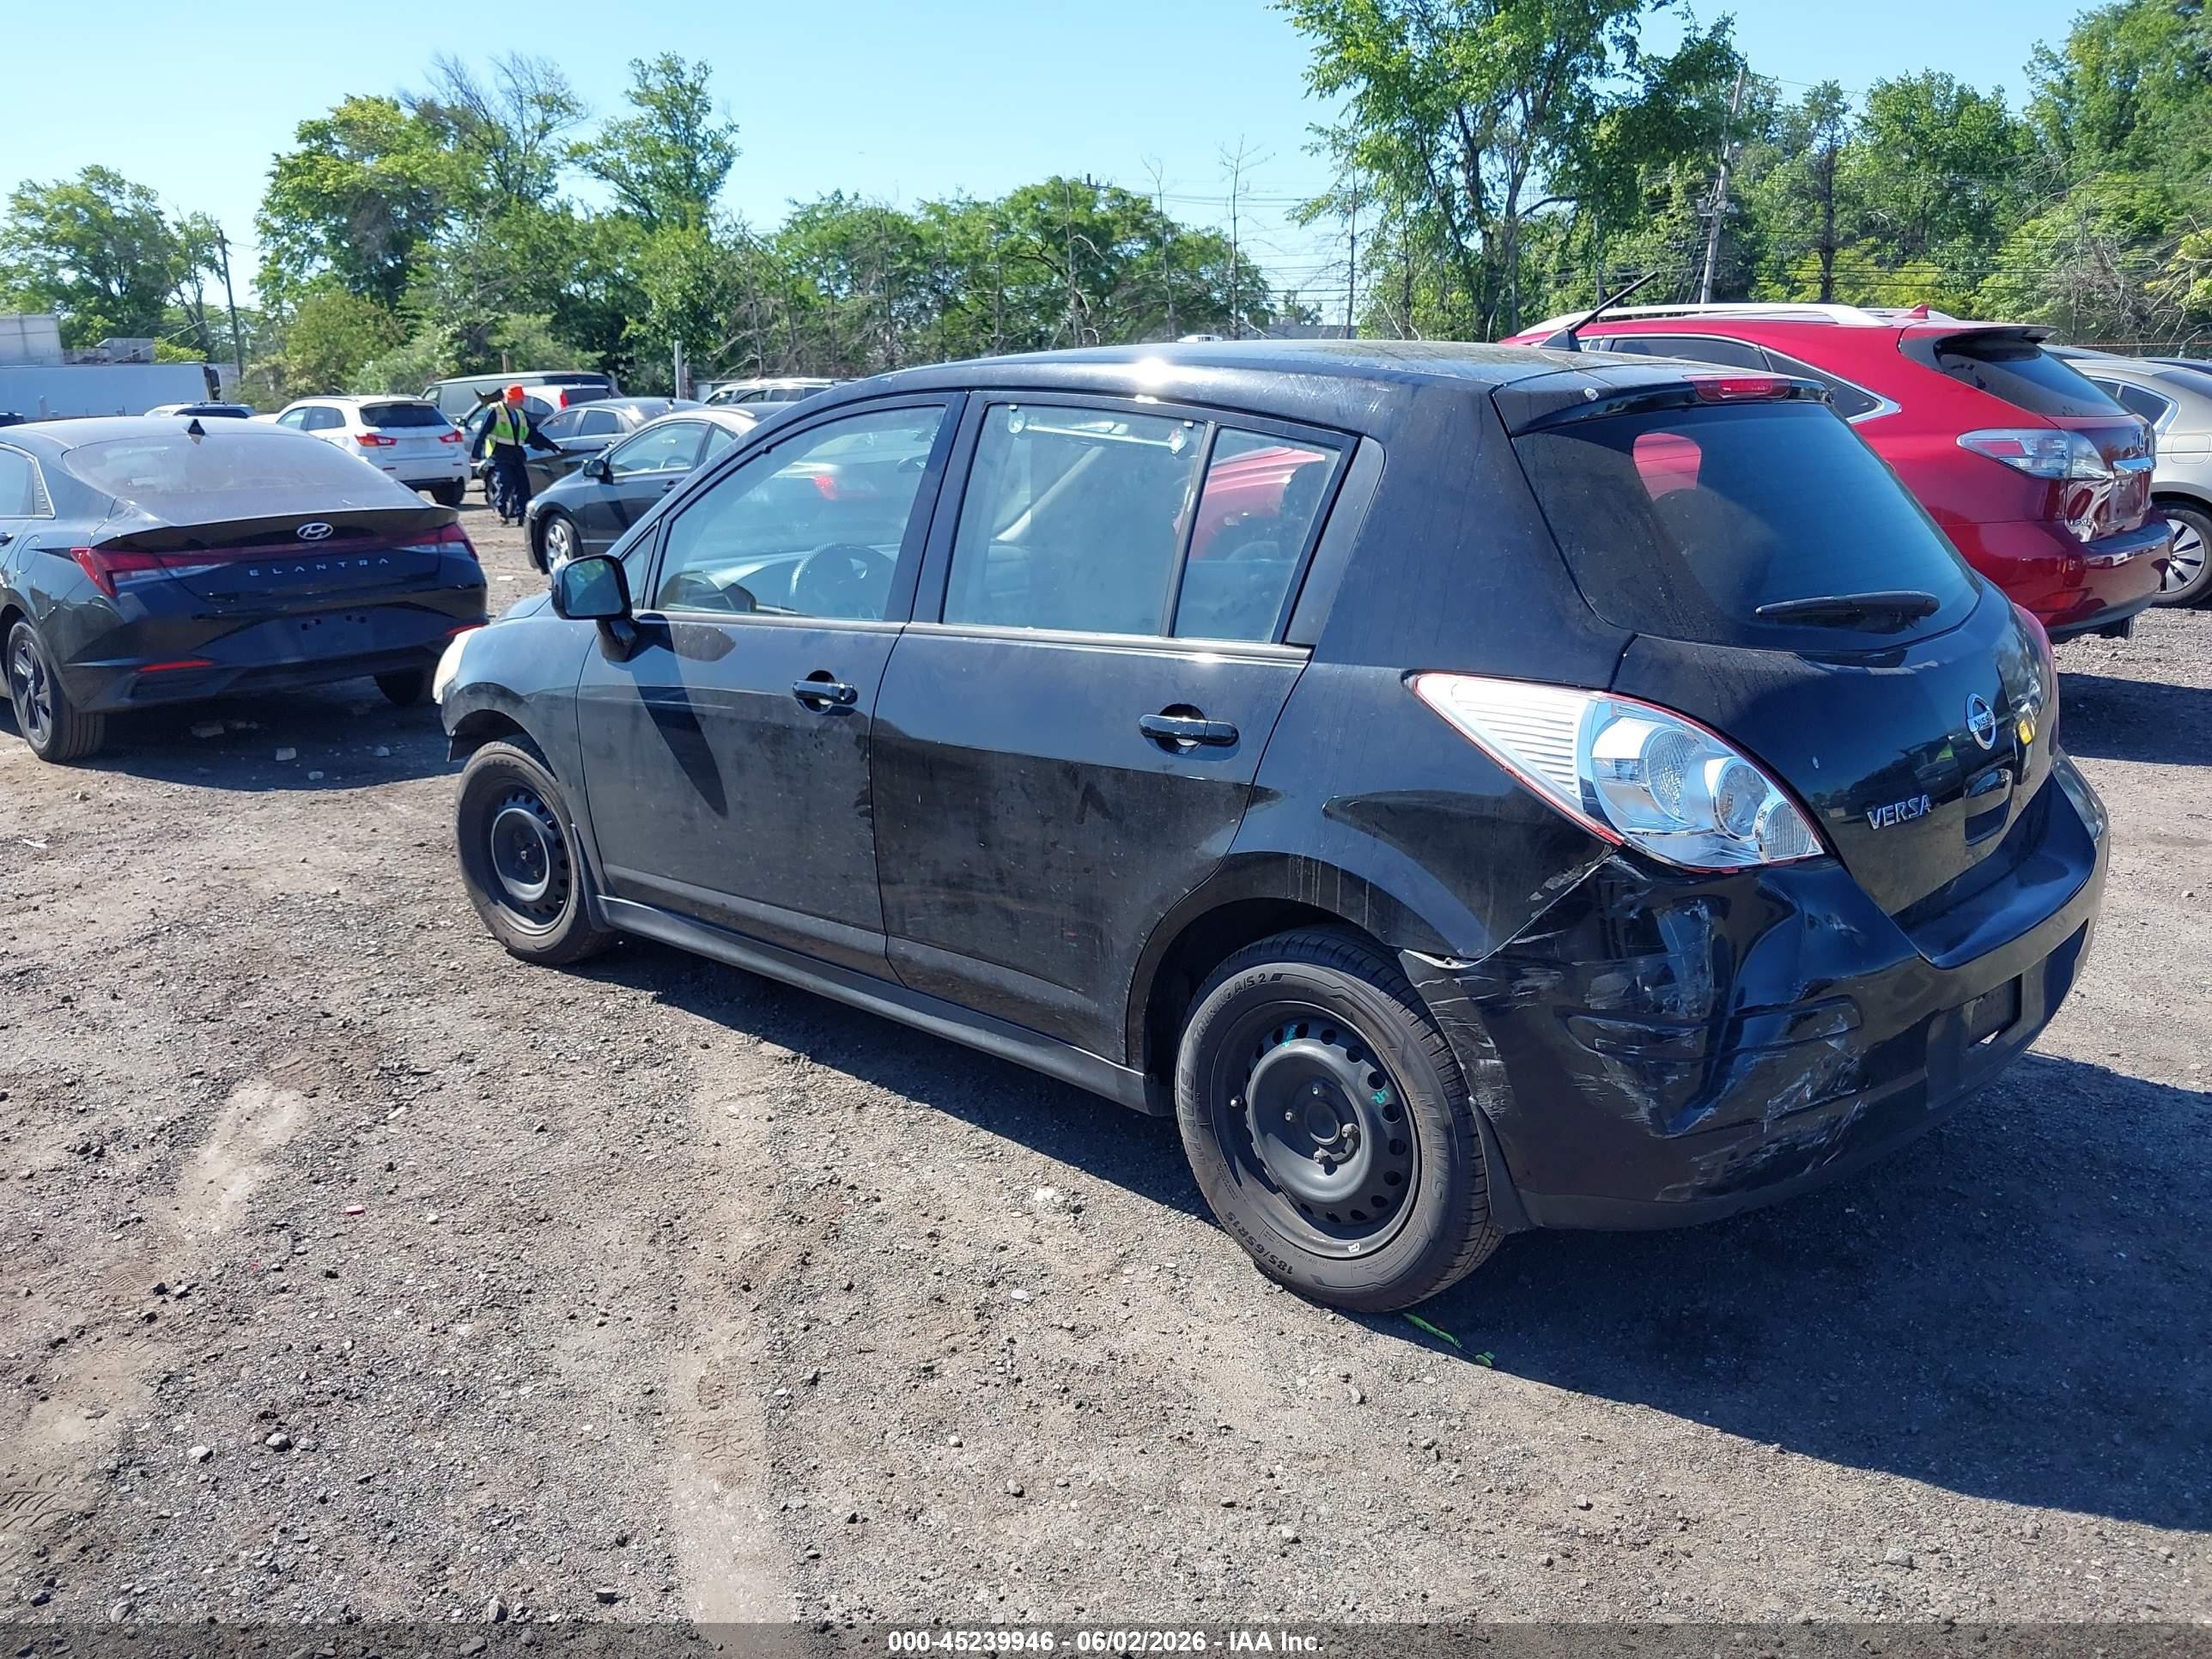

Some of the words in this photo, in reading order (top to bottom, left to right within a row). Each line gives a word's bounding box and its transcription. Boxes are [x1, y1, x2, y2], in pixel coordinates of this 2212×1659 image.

[249, 558, 389, 576] ELANTRA
[1867, 794, 1933, 830] VERSA
[1225, 1211, 1294, 1275] 185/65R15
